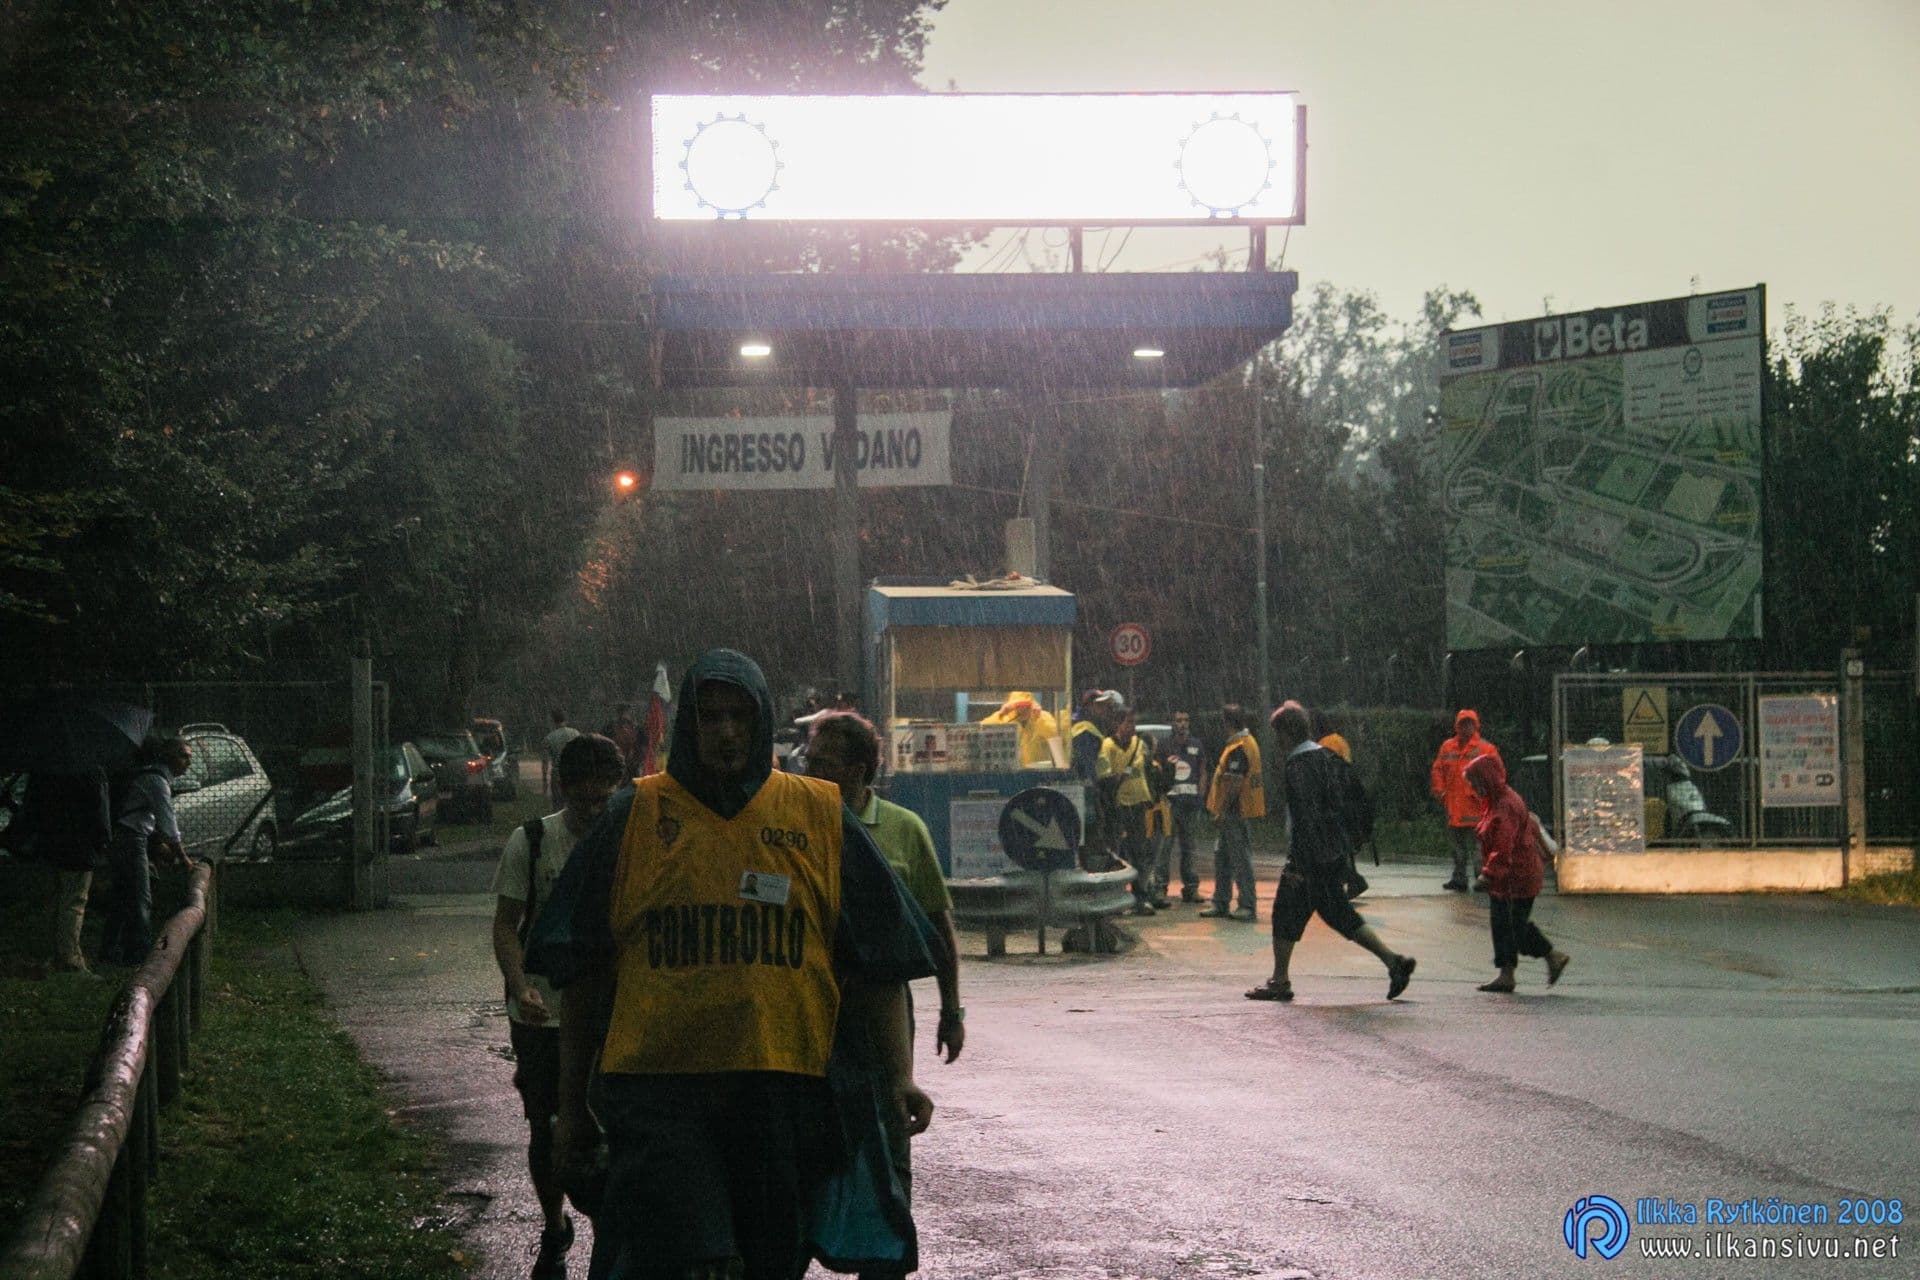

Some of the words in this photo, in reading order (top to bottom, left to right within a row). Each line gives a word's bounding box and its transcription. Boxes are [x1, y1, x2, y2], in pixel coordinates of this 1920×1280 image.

[1566, 313, 1648, 356] Beta
[681, 432, 805, 474] INGRESSO
[821, 427, 922, 472] VDANO
[1119, 633, 1142, 655] 30
[760, 826, 808, 851] 0290
[646, 903, 806, 969] CONTROLLO
